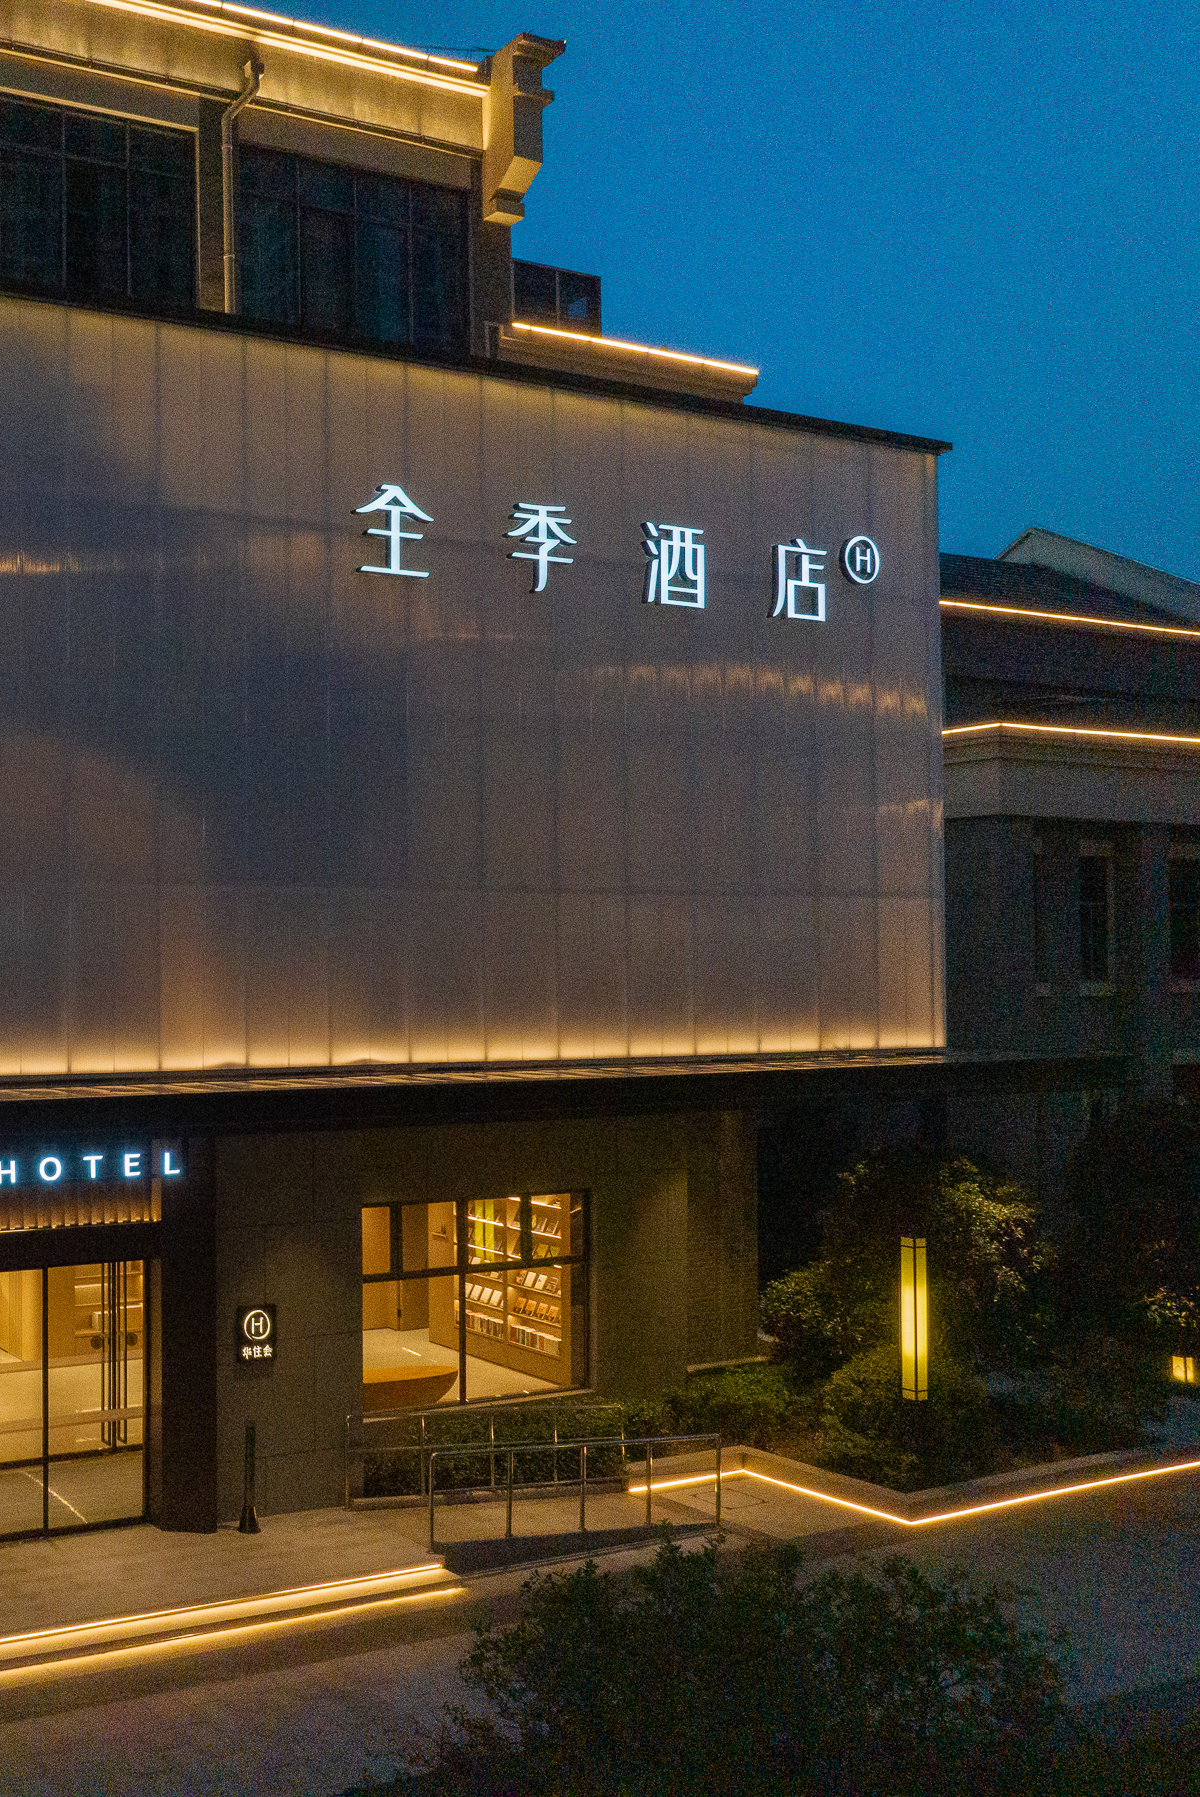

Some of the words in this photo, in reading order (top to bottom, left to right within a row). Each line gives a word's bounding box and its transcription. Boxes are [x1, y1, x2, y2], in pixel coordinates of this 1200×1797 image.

[354, 483, 828, 622] 全季酒店
[242, 1344, 273, 1360] 华住会
